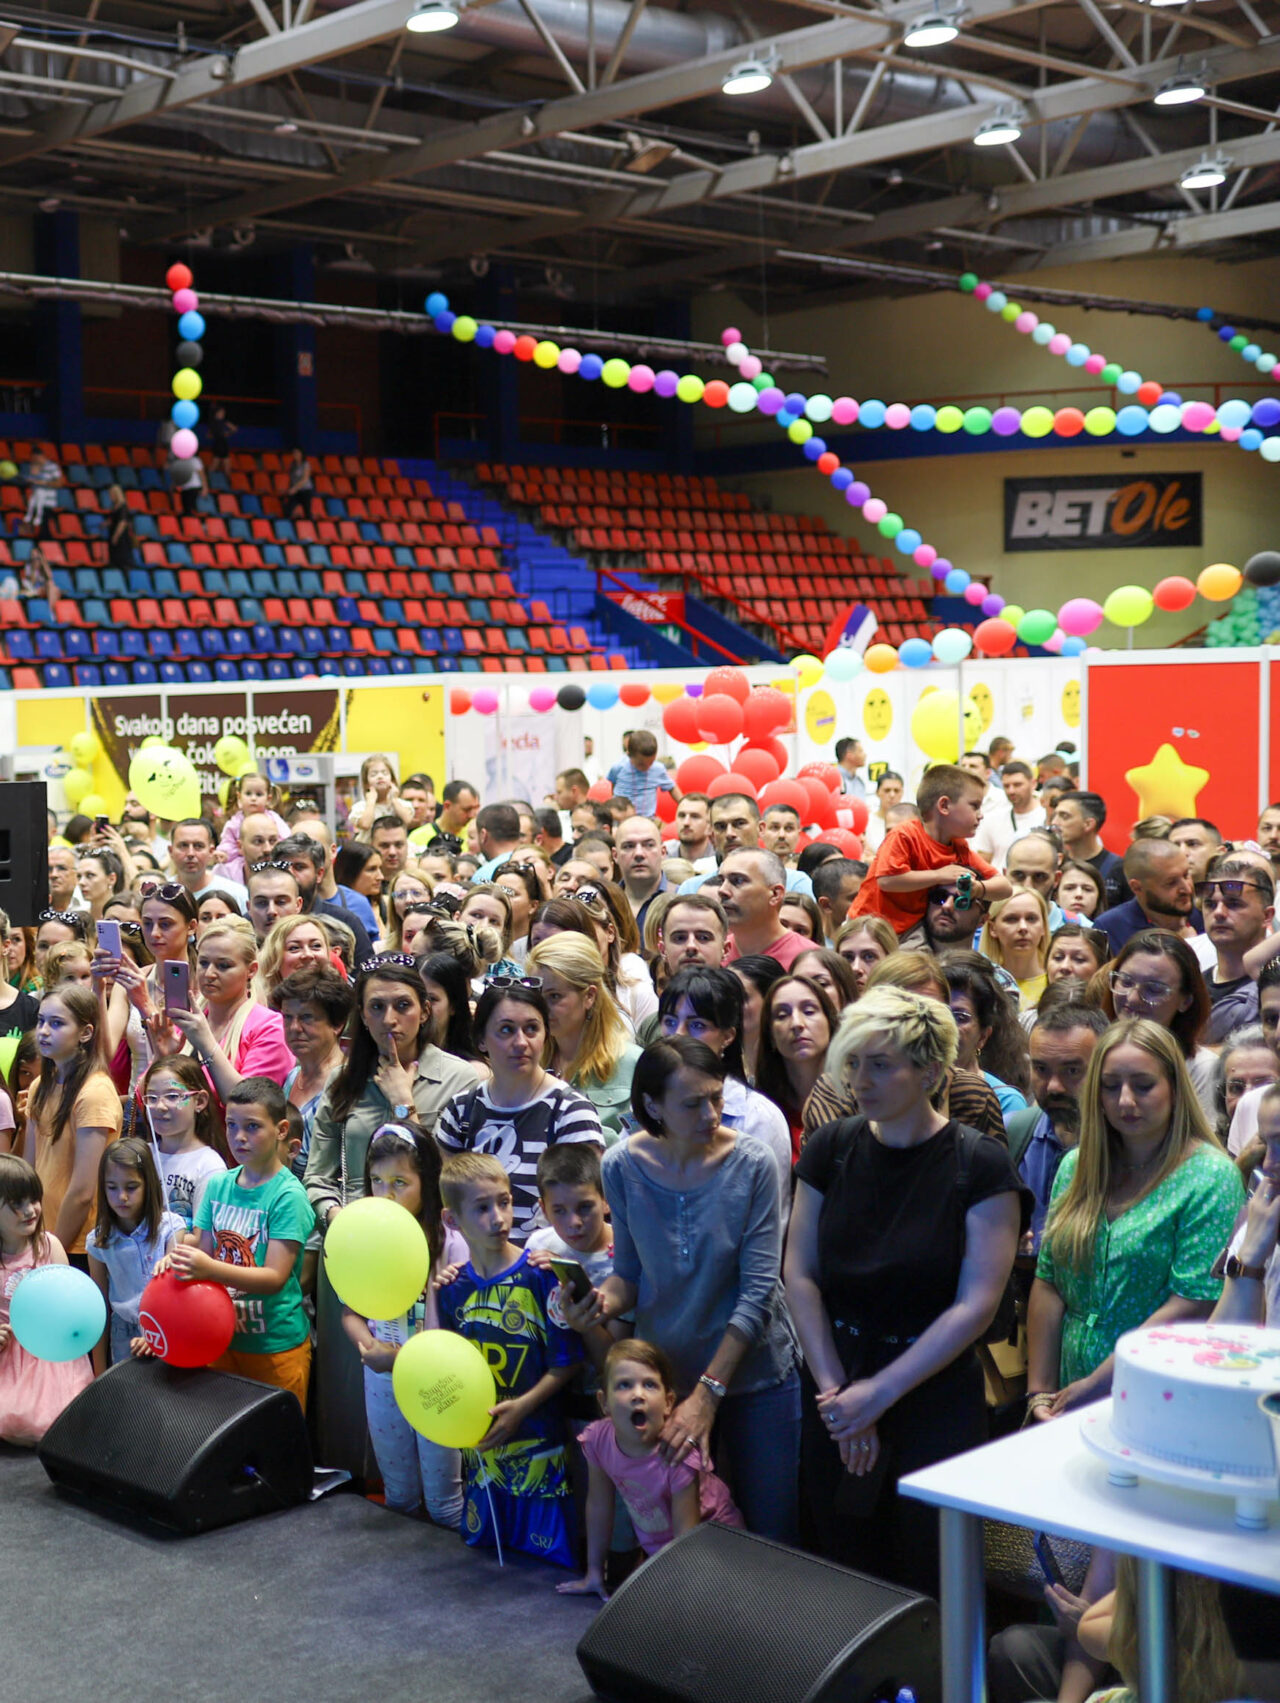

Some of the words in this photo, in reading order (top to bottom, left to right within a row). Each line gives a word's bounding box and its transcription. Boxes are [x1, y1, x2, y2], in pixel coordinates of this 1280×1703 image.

[115, 714, 174, 740] Svakog
[177, 712, 219, 735] dana
[223, 708, 312, 738] posvećen
[471, 1339, 529, 1388] R7
